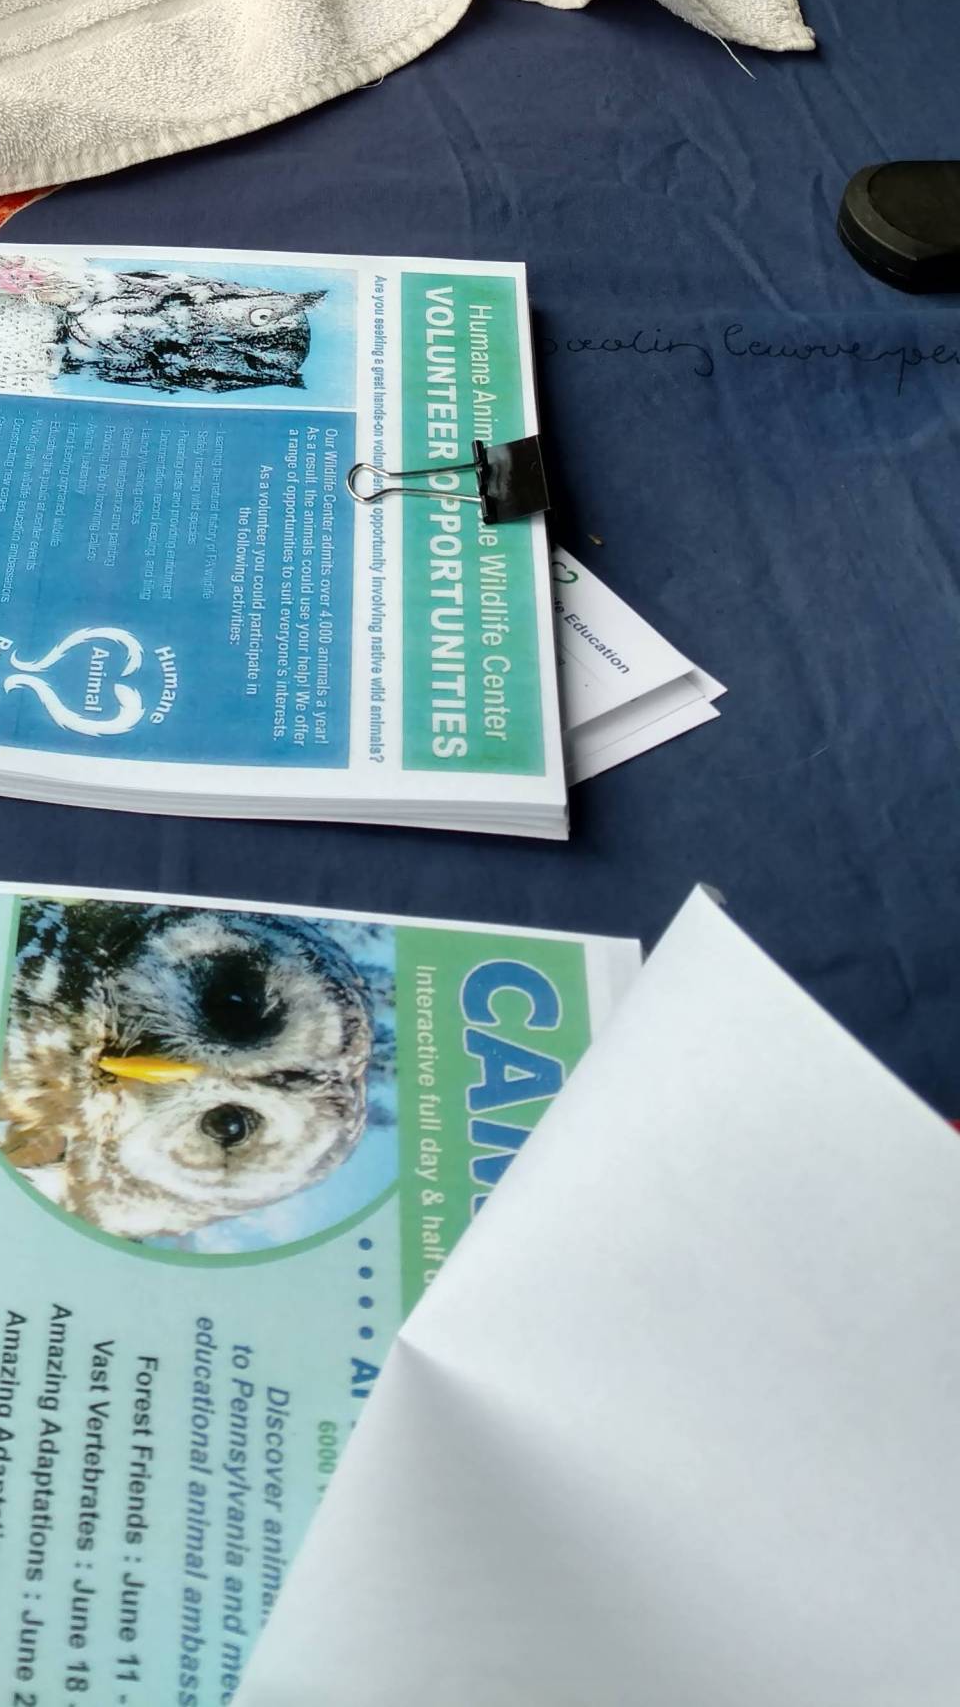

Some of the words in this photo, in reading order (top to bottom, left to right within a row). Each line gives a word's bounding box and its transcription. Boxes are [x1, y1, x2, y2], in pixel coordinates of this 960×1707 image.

[370, 295, 383, 315] you
[374, 275, 385, 293] Are
[370, 317, 385, 356] seeking
[468, 304, 495, 386] Humane
[370, 366, 385, 390] great
[424, 284, 458, 461] VOLUNTEER
[324, 428, 336, 447] Our
[372, 392, 385, 437] hands-on
[471, 389, 498, 447] Anim
[323, 450, 336, 491] Wildlife
[321, 493, 335, 531] Center
[367, 508, 385, 572] opportunity
[320, 534, 334, 575] admits
[319, 579, 330, 605] over
[367, 576, 384, 633] involving
[427, 472, 467, 760] OPPORTUNITIES
[477, 551, 508, 647] Wildlife
[316, 646, 331, 696] animals
[370, 636, 384, 674] native
[564, 613, 631, 675] Education
[86, 646, 109, 712] Animal
[150, 645, 179, 724] Humane
[370, 676, 384, 703] wild
[481, 654, 513, 741] Center
[311, 711, 329, 744] year!
[369, 705, 384, 763] animals?
[416, 964, 440, 1086] Interactive
[419, 1093, 442, 1130] full
[415, 1137, 443, 1180] day
[422, 1188, 444, 1206] &
[423, 1215, 446, 1261] half
[89, 1339, 114, 1393] Vast
[232, 1344, 254, 1369] to
[132, 1356, 158, 1436] Forest
[189, 1316, 217, 1474] educational
[220, 1377, 253, 1567] Pennsylvania
[263, 1386, 289, 1511] Discover
[317, 1420, 336, 1473] 6000
[75, 1400, 109, 1551] Vertebrates
[124, 1444, 152, 1545] Friends
[184, 1481, 211, 1578] animal
[260, 1518, 287, 1623] anima
[67, 1578, 95, 1649] June
[117, 1572, 143, 1642] June
[223, 1576, 248, 1634] and
[63, 1660, 88, 1692] 18
[114, 1653, 138, 1682] 11
